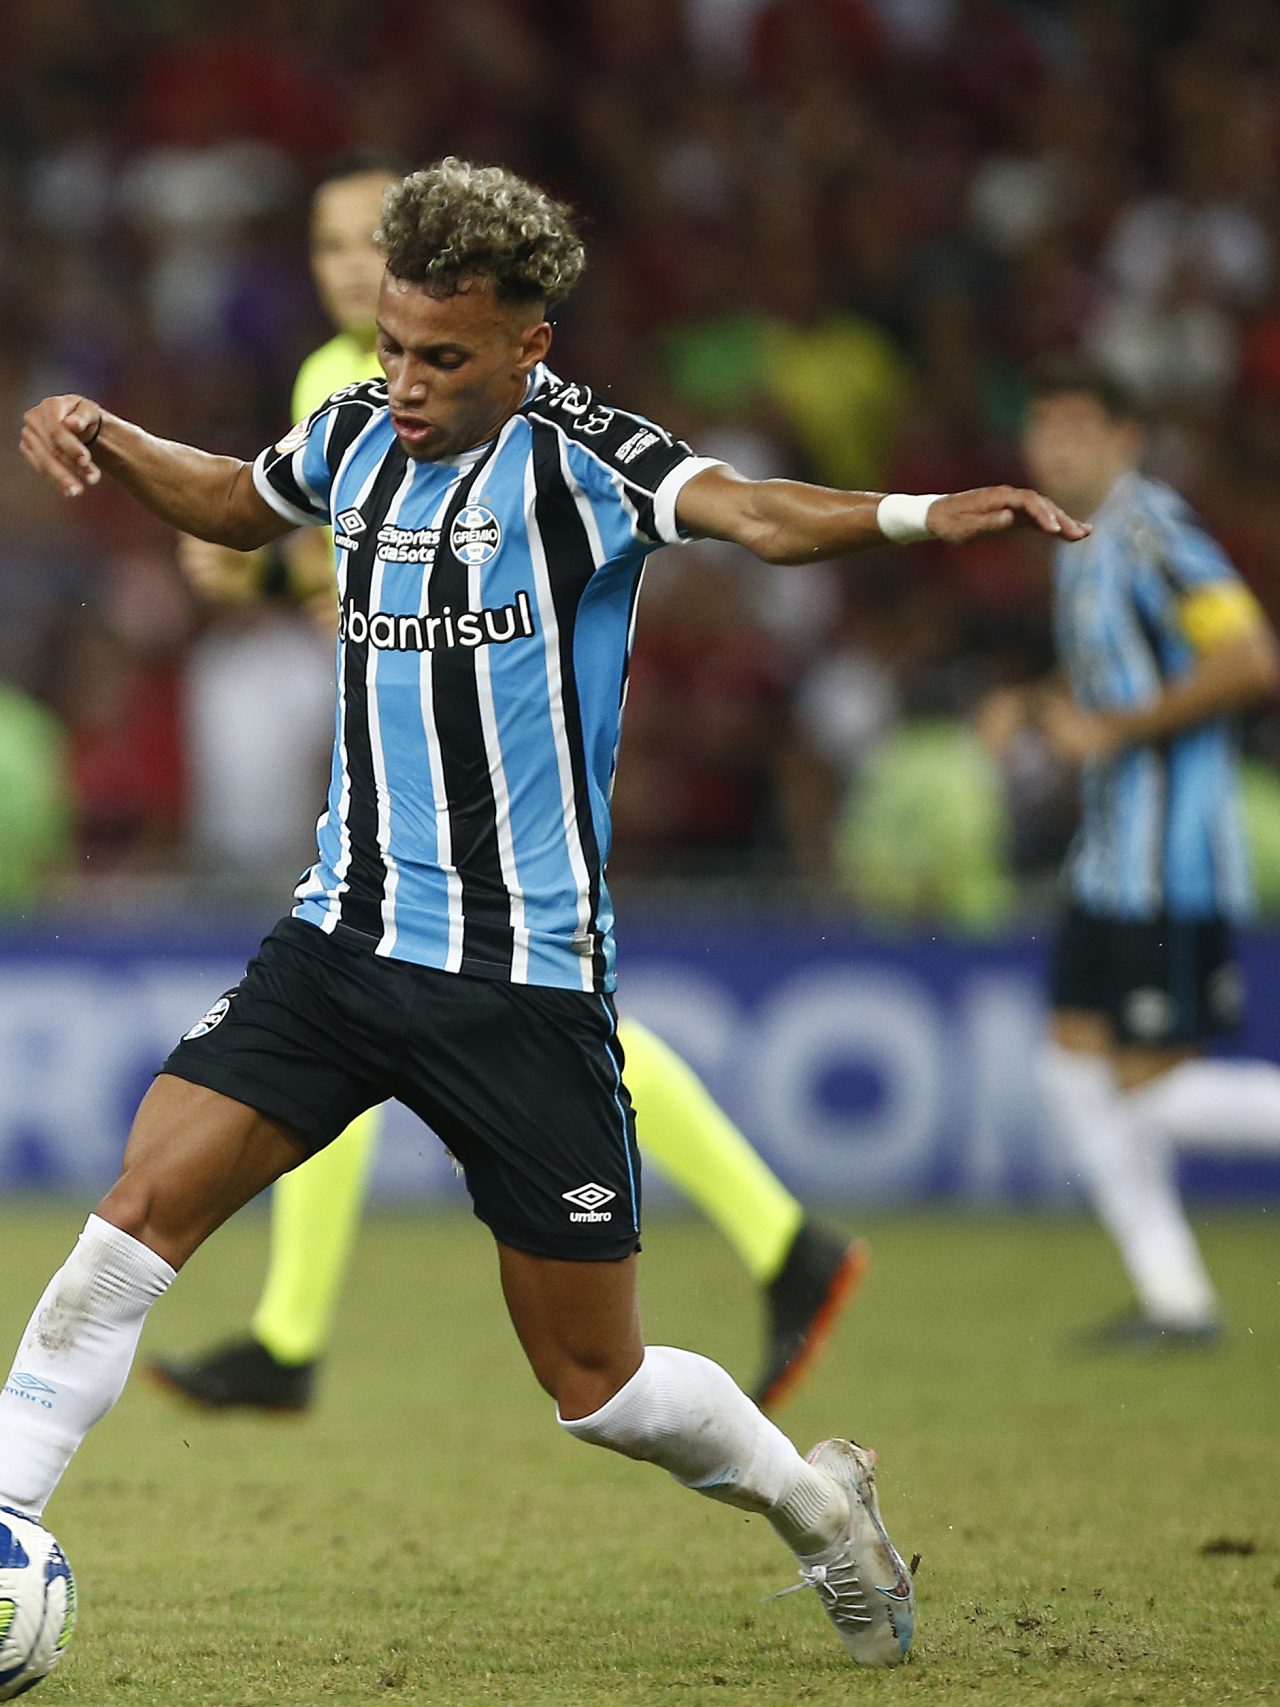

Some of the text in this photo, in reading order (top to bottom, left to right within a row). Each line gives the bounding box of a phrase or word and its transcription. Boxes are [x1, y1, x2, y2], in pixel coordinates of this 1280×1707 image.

[348, 592, 534, 649] banrisul
[569, 1210, 612, 1222] umbro
[3, 1387, 53, 1409] mbro
